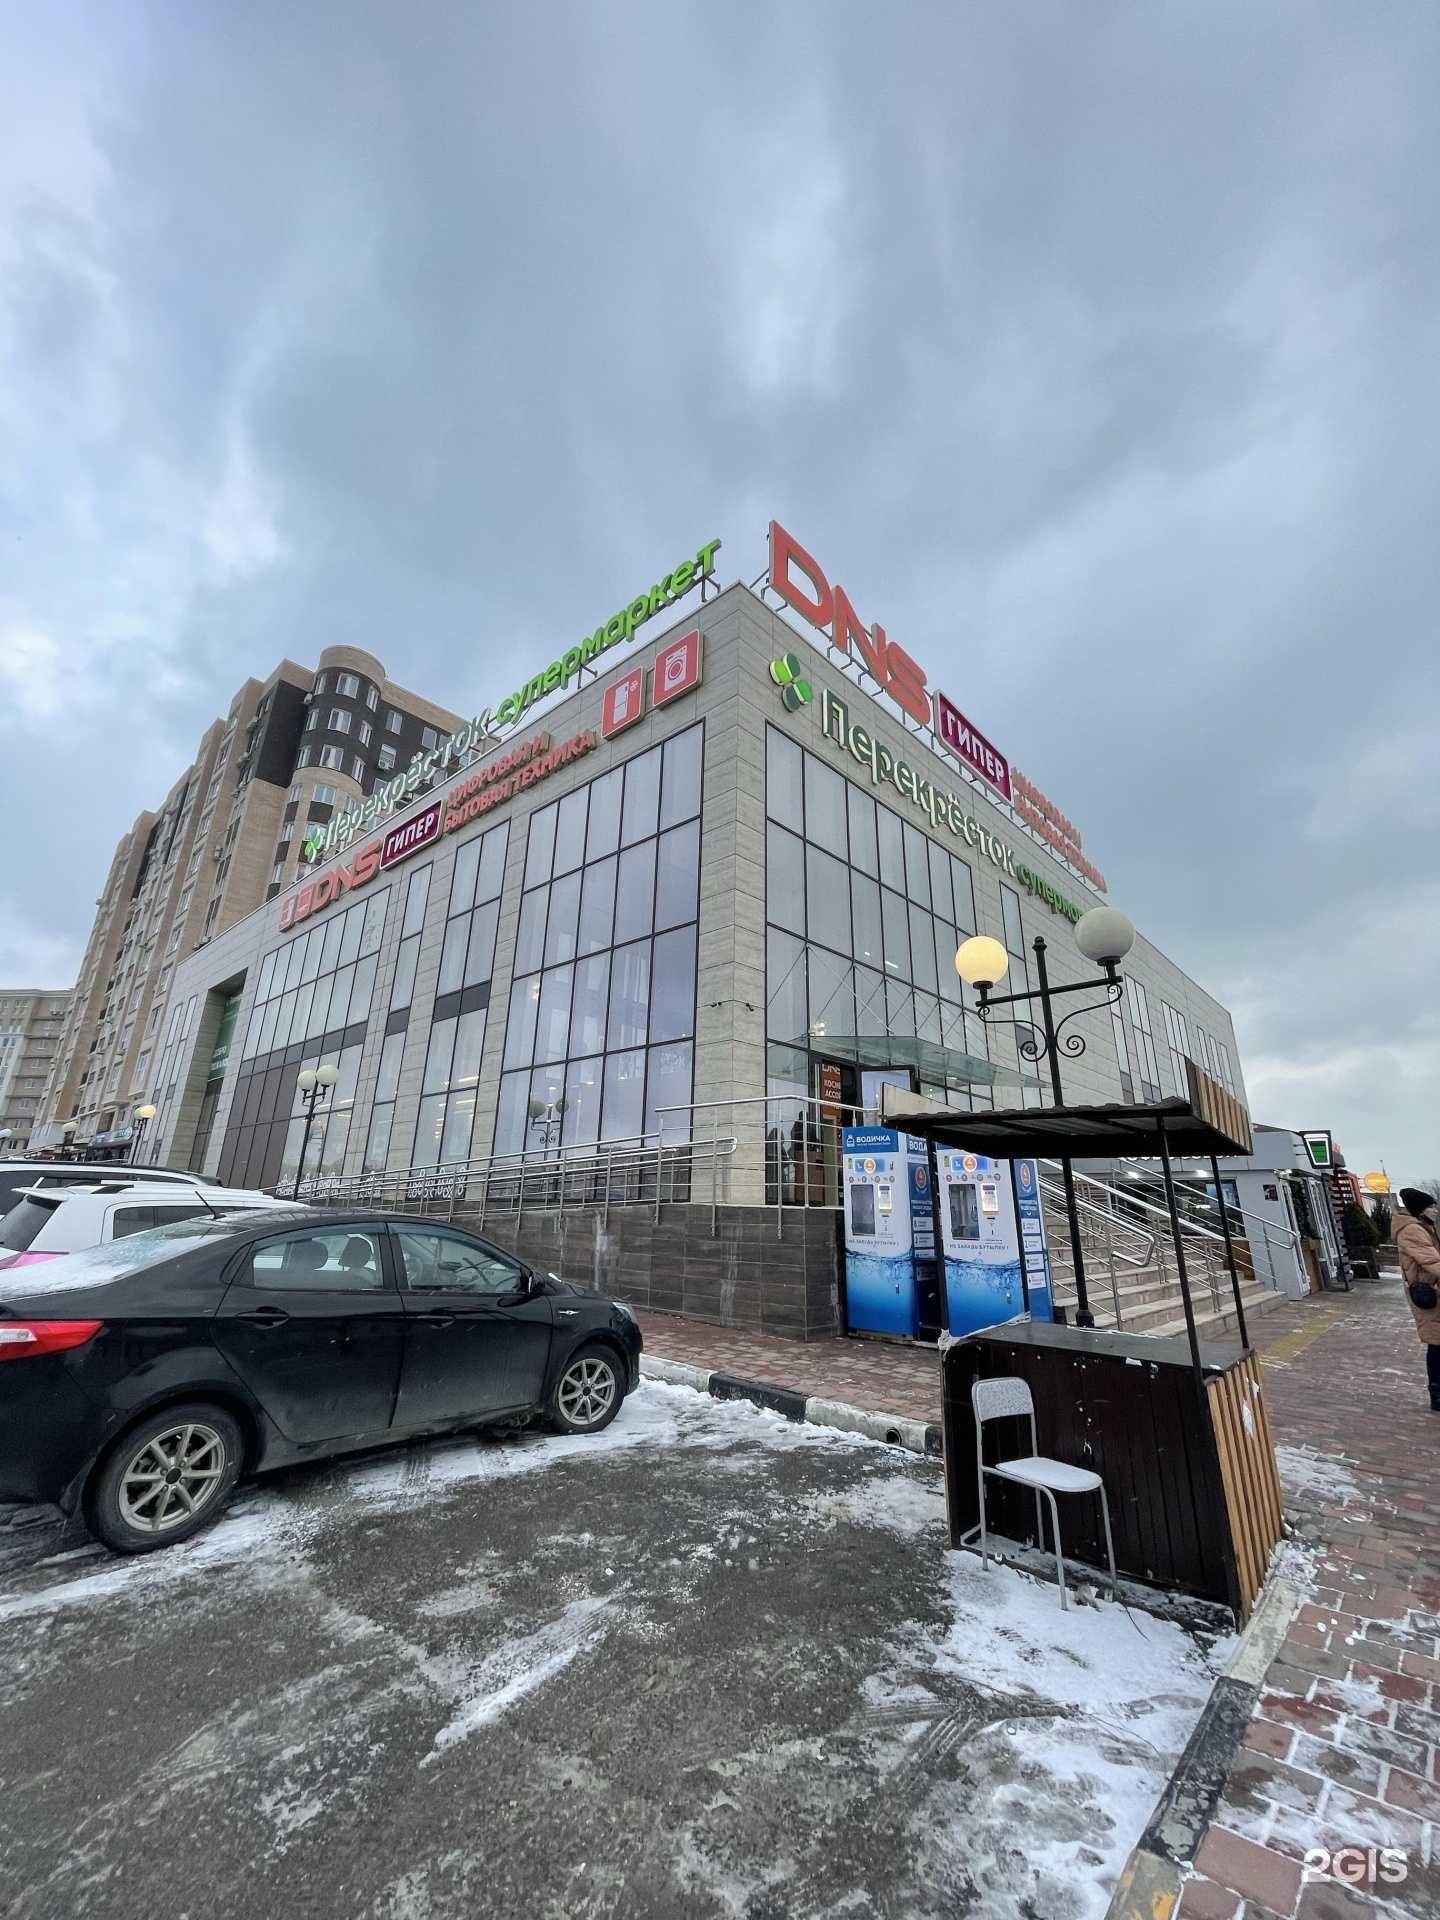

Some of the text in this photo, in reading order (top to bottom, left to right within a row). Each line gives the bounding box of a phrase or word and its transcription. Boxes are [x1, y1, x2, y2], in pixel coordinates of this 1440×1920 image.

[496, 538, 722, 724] супермаркет
[768, 519, 930, 726] DNS
[444, 729, 596, 833] БЫТОВАЯ ТЕХНИКА
[822, 688, 1016, 877] Перекрёсток
[945, 709, 1005, 782] ГИПЕР
[386, 812, 435, 857] ГИПЕР
[311, 838, 382, 913] DNS
[856, 1135, 891, 1143] ВОДИЧКА
[909, 1140, 928, 1151] ВОДА
